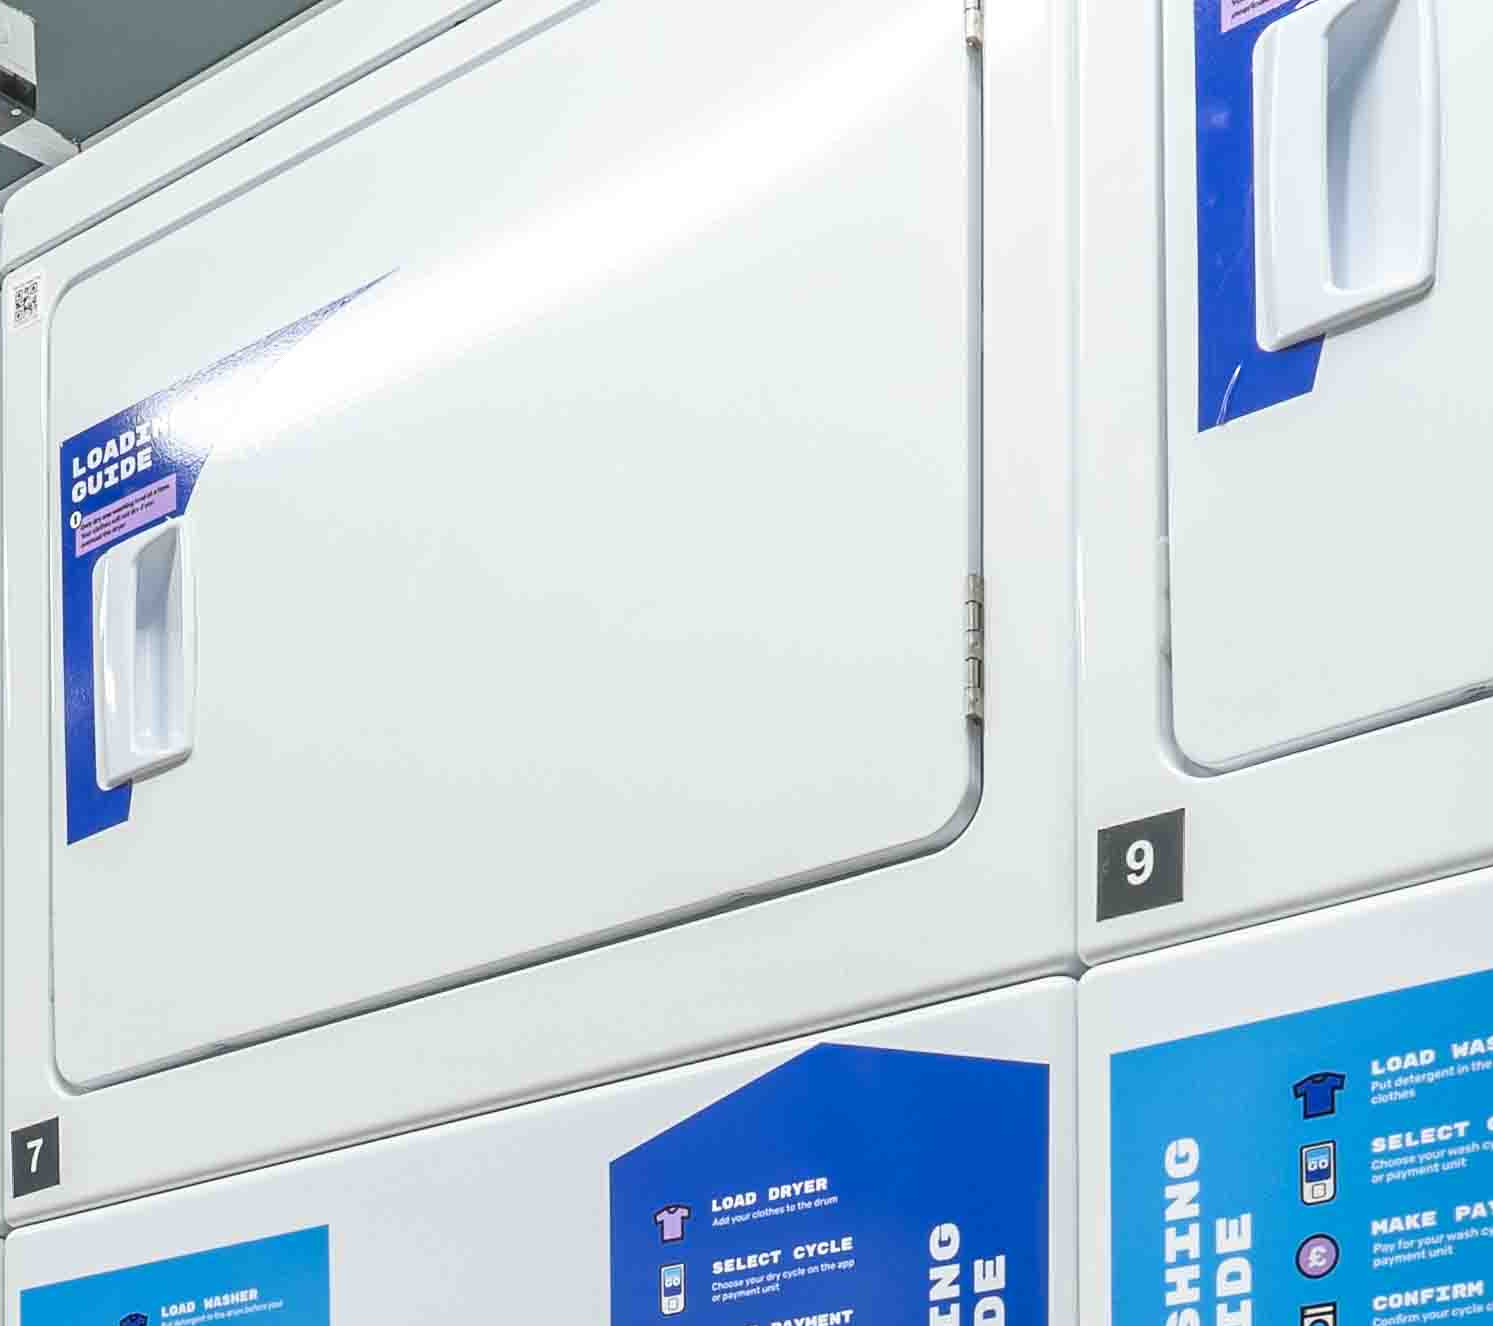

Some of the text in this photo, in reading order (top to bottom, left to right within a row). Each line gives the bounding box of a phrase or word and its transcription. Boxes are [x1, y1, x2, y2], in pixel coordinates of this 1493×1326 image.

[72, 417, 169, 479] LOADIN
[71, 446, 153, 503] GUIDE
[1126, 840, 1154, 886] 9
[1371, 1049, 1436, 1076] LOAD
[1371, 1120, 1470, 1153] SELECT
[27, 1138, 43, 1173] 7
[711, 1177, 828, 1212] LOAD DRYER
[1371, 1210, 1437, 1236] MAKE
[712, 1236, 853, 1275] SELECT CYCLE
[161, 1288, 259, 1318] LOAD WASHER
[1372, 1279, 1484, 1312] CONFIRM
